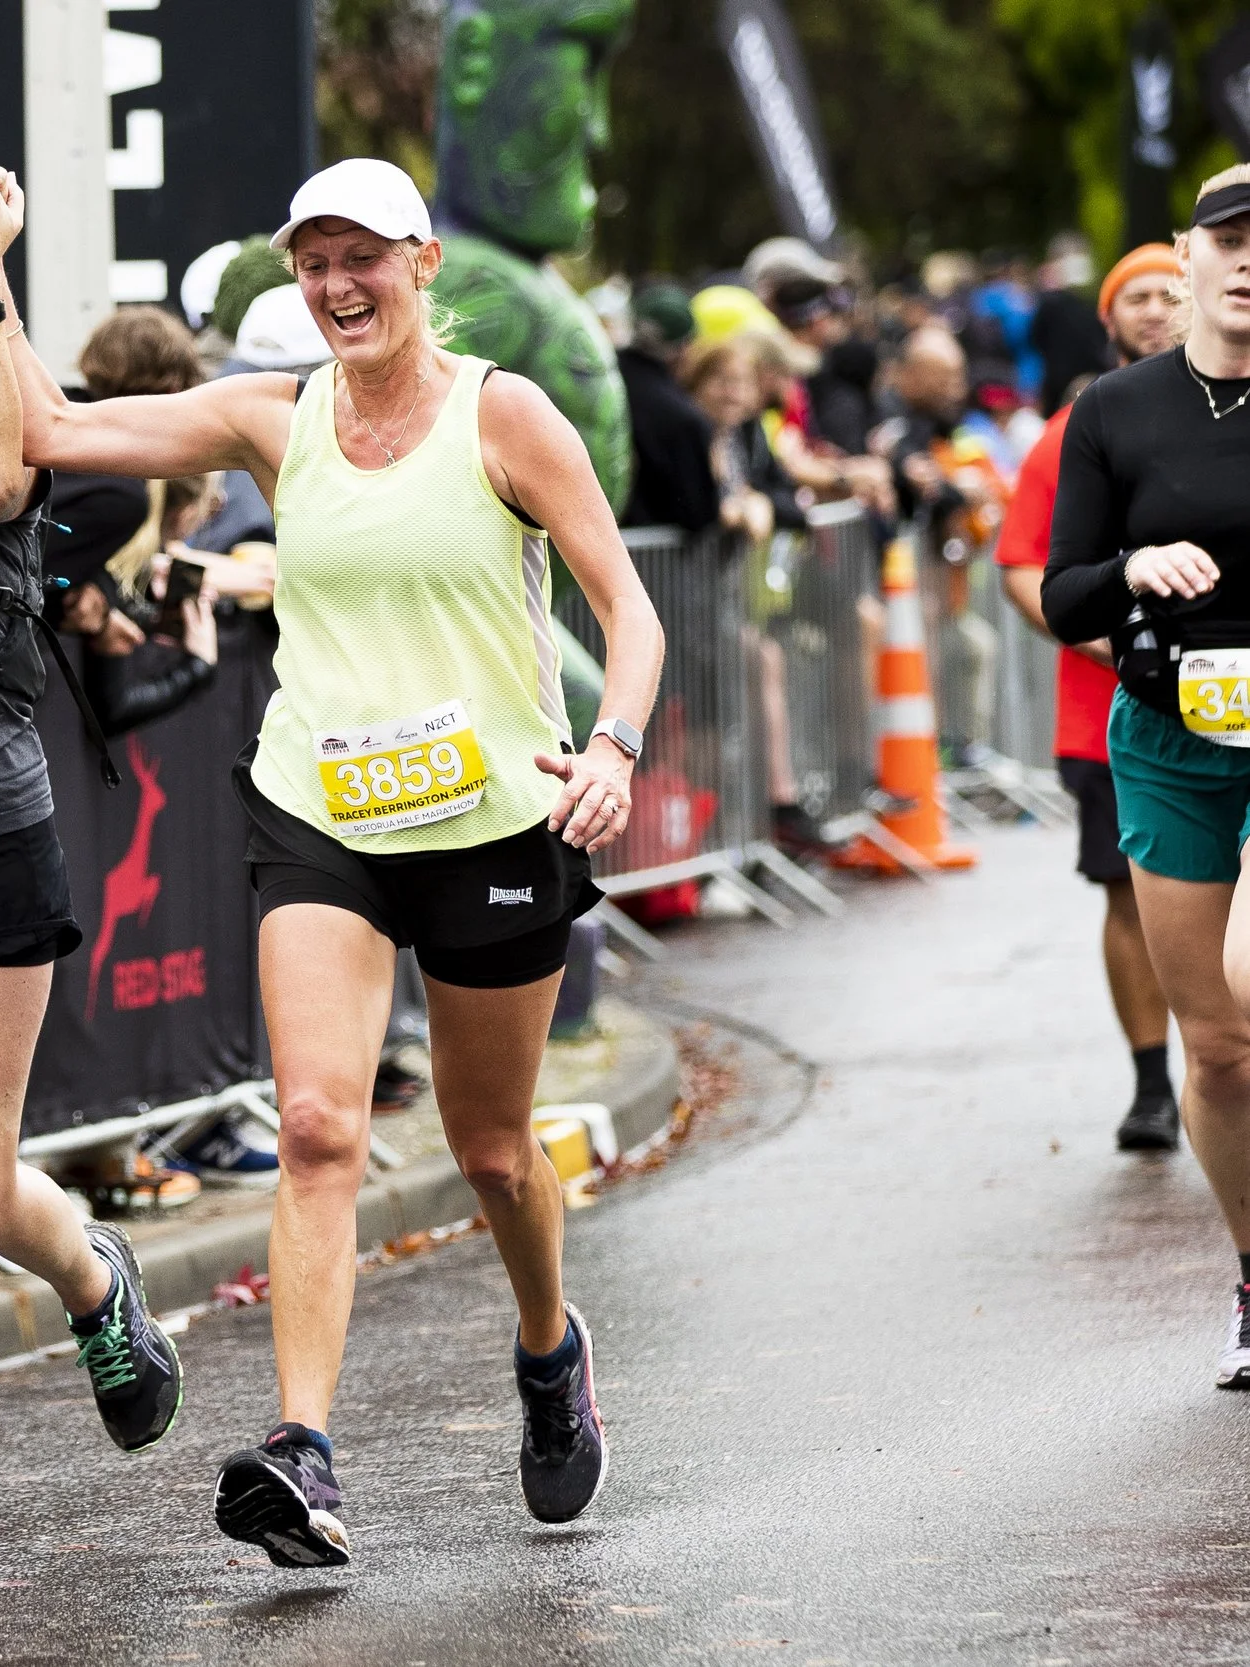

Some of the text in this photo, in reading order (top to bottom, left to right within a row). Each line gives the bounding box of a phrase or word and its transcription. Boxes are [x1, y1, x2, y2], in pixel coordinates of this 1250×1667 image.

[425, 712, 456, 733] NZCT
[322, 741, 348, 752] ROTORUA
[336, 741, 465, 807] 3859
[331, 777, 488, 822] TRACEY BERRINGTON-SMITH
[353, 798, 475, 833] ROTORUA HALF MARATHON
[488, 886, 533, 904] LONSDALE
[113, 957, 157, 1011] RED
